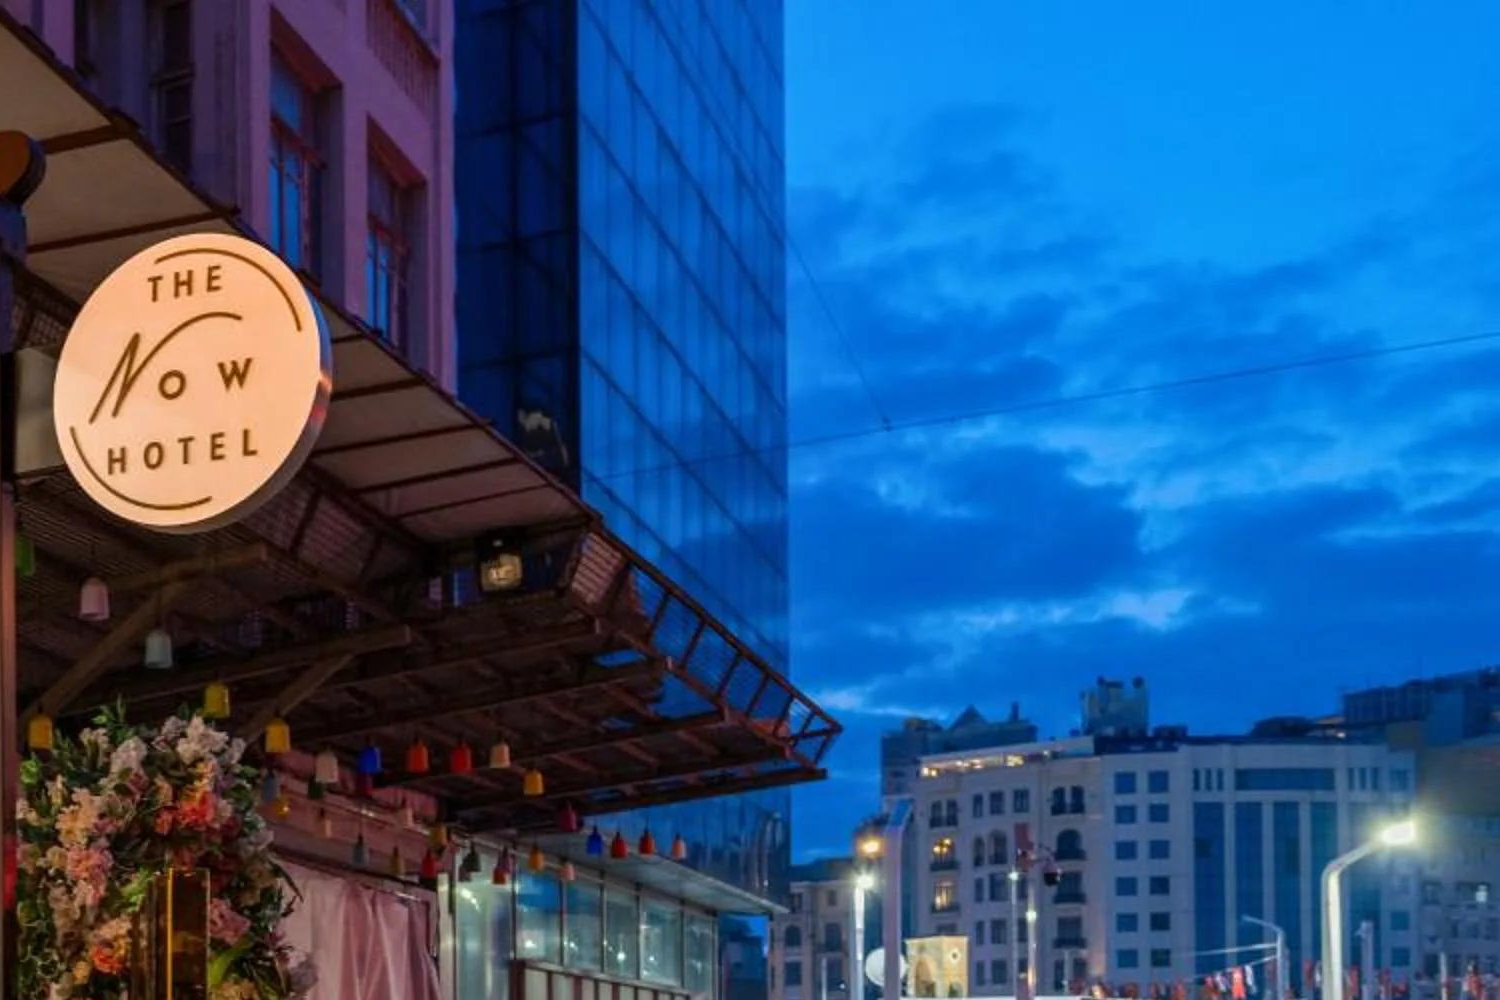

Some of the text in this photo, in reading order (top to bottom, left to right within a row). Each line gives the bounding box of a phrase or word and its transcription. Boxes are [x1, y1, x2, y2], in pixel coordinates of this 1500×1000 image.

[147, 265, 222, 303] THE
[89, 311, 253, 425] NOW
[106, 429, 259, 476] HOTEL
